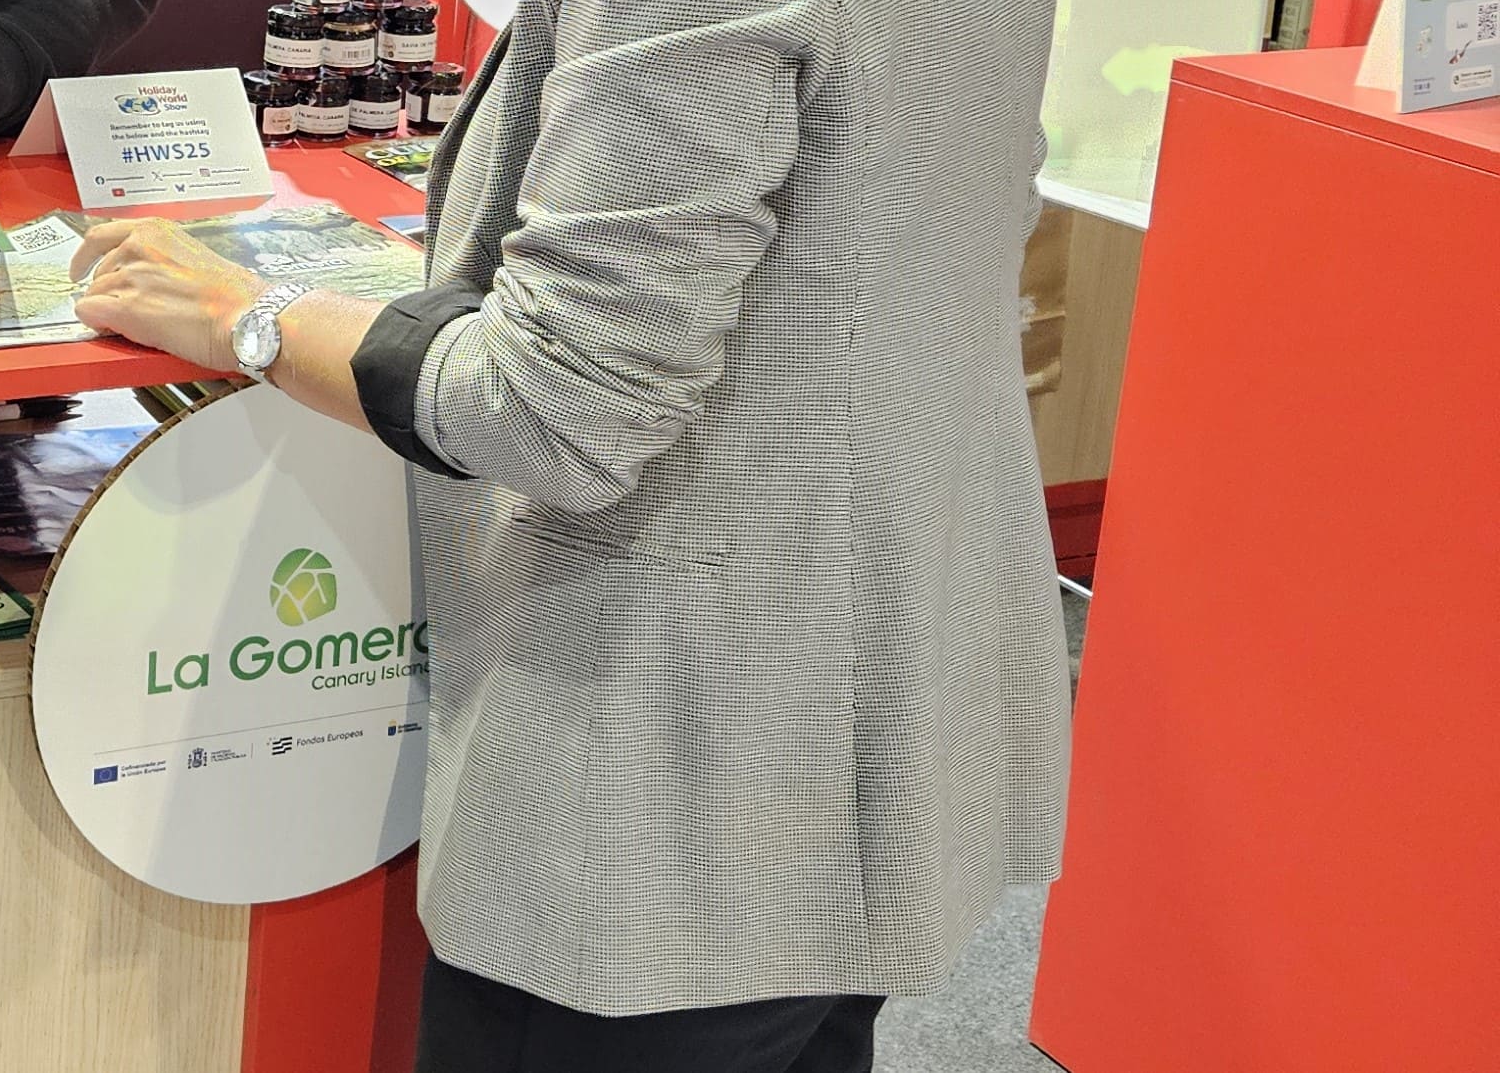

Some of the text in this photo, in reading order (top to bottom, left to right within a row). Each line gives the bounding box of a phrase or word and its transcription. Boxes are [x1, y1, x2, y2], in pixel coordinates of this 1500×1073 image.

[138, 86, 177, 96] Holiday
[159, 94, 188, 103] World
[164, 103, 188, 111] Show
[110, 123, 150, 131] Remember
[162, 121, 174, 129] tag
[185, 119, 206, 127] using
[126, 132, 148, 140] below
[150, 130, 164, 138] and
[180, 128, 210, 136] hashtag
[122, 143, 211, 164] #HWS25
[147, 650, 209, 695] La
[311, 667, 376, 691] Canary
[296, 729, 364, 747] Fondos Europeos
